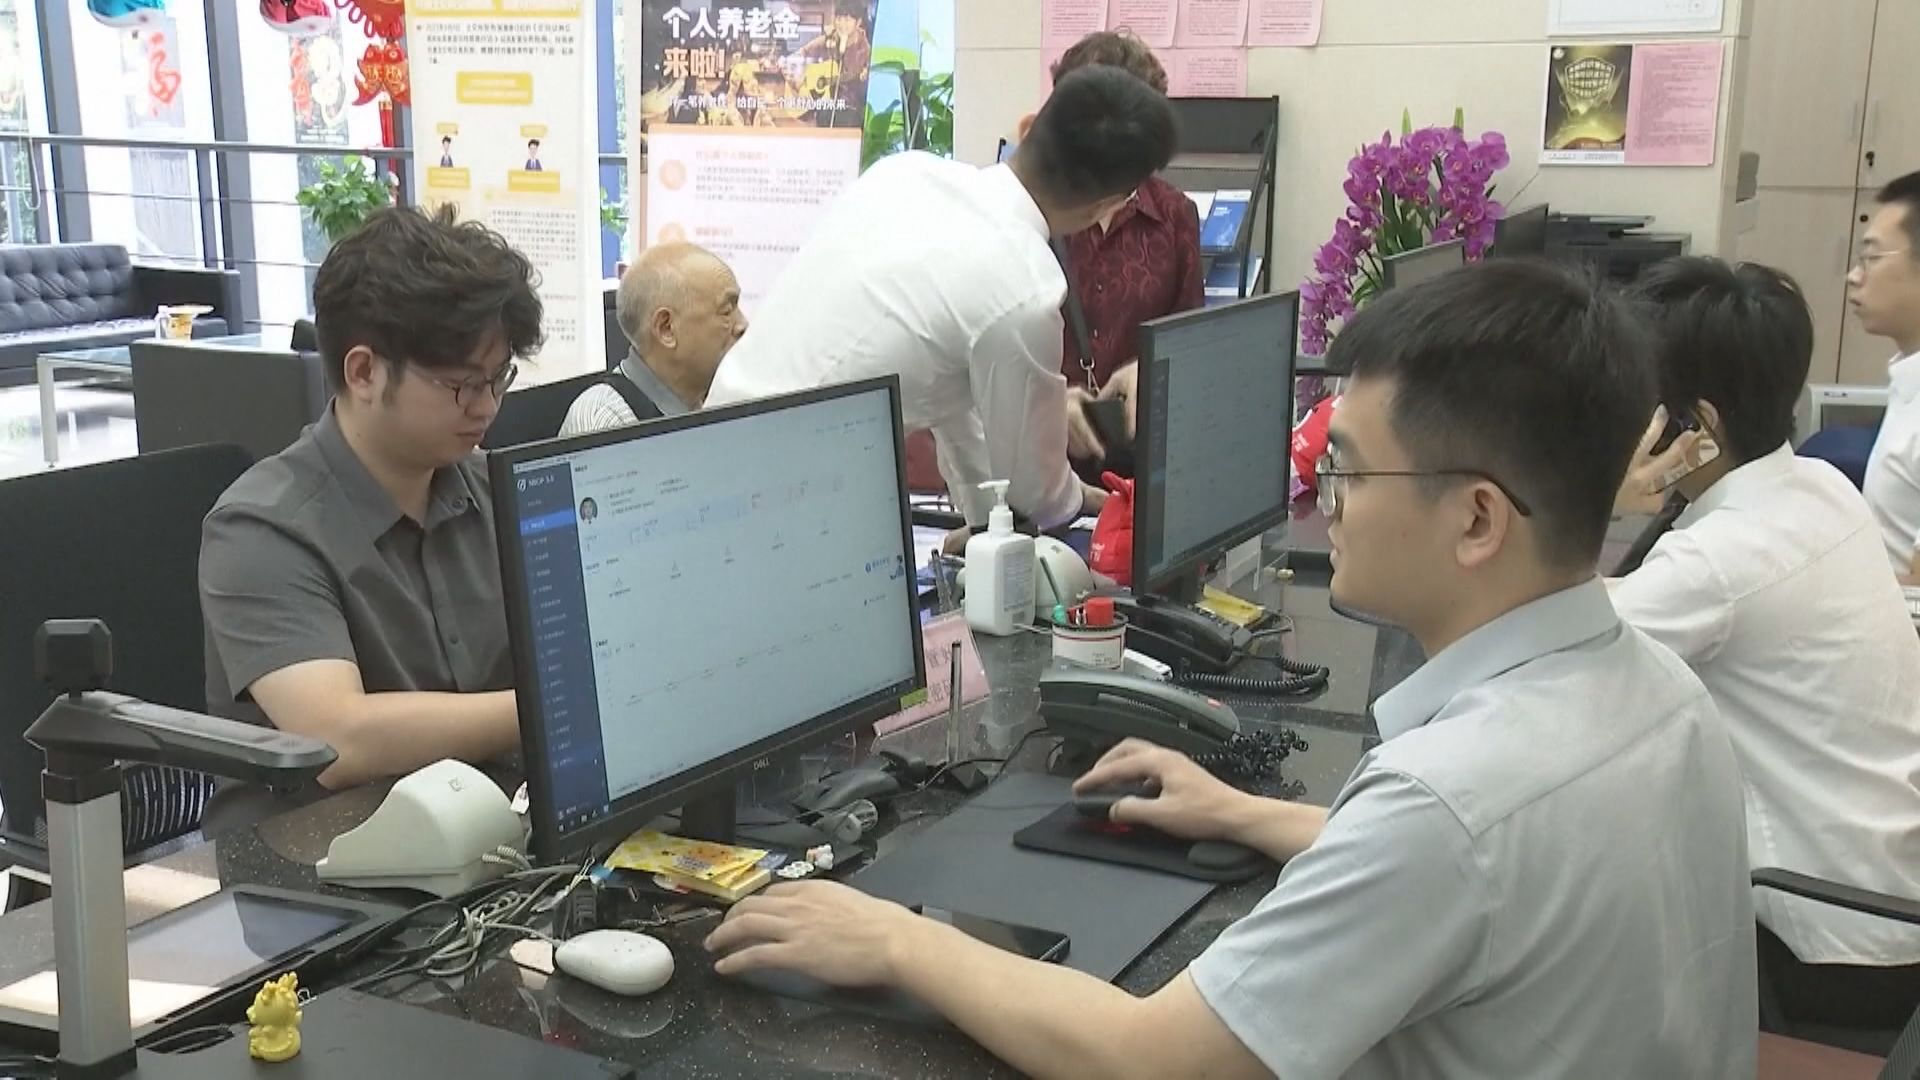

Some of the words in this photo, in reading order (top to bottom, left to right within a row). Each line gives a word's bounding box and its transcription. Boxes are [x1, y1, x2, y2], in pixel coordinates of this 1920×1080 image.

[662, 7, 800, 39] 个人养老金
[663, 47, 726, 79] 来啦!
